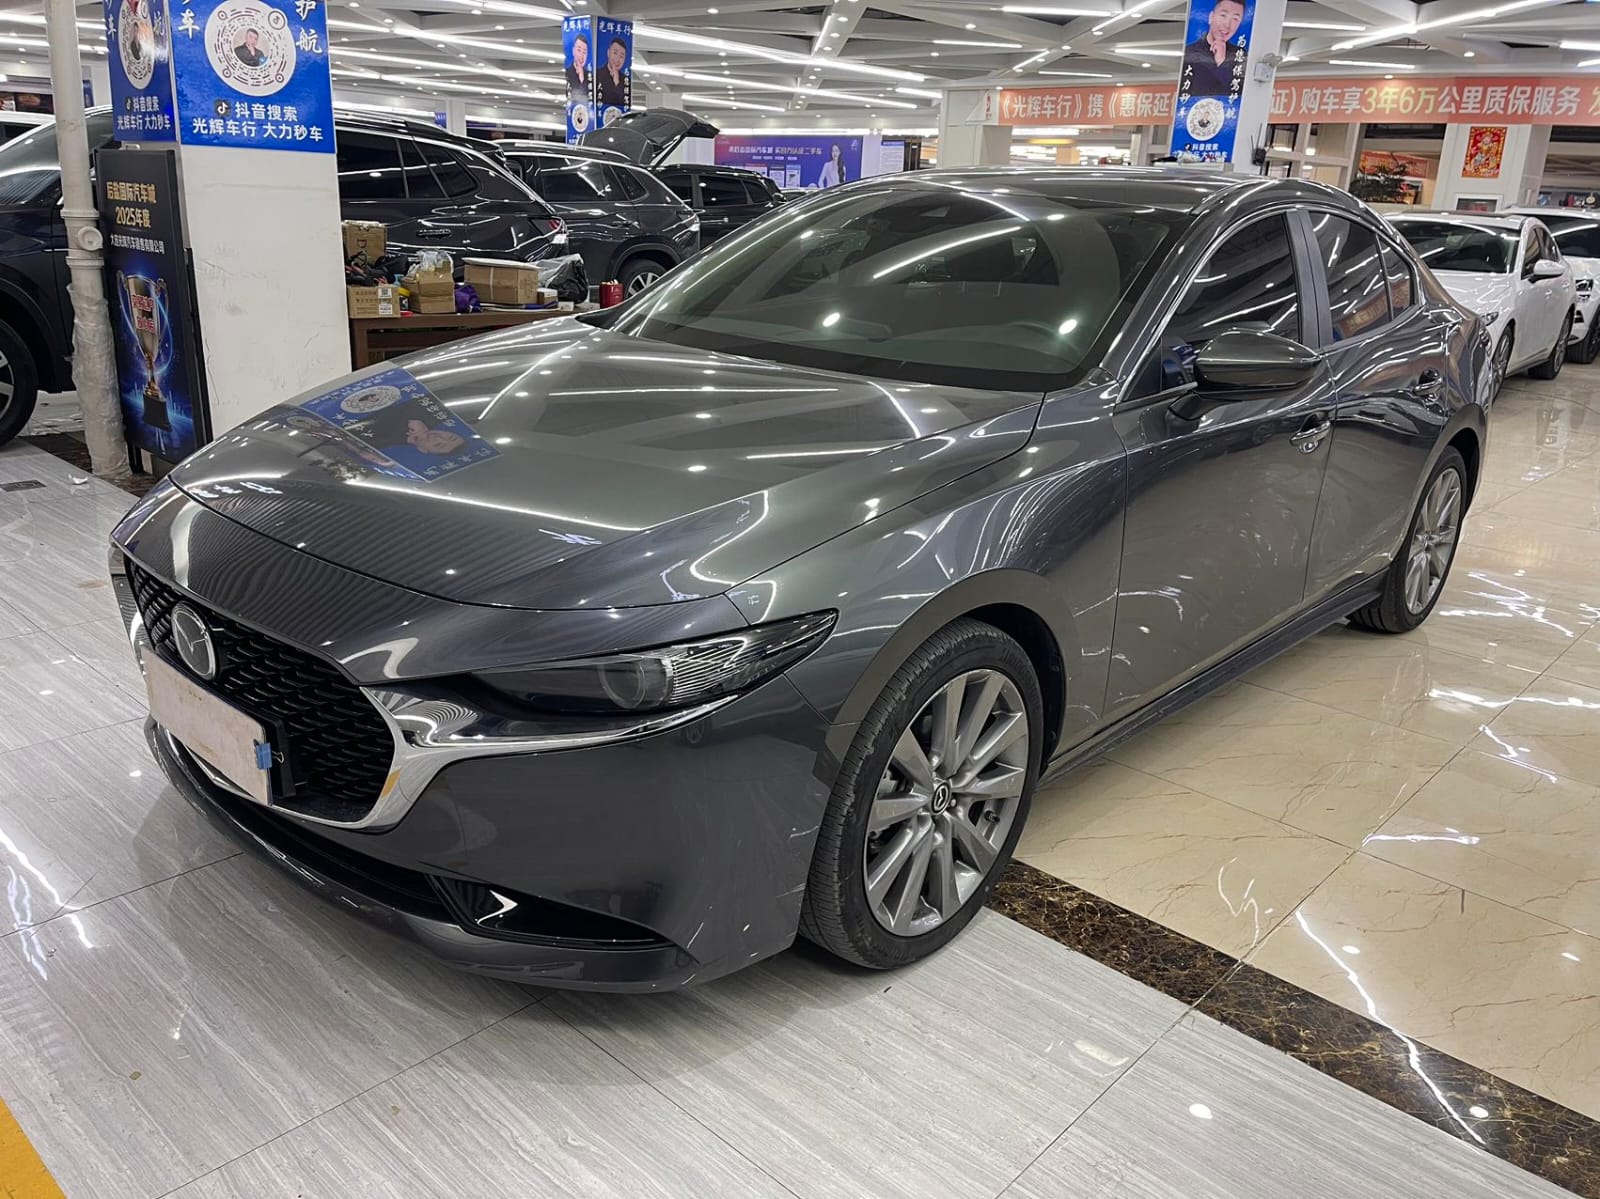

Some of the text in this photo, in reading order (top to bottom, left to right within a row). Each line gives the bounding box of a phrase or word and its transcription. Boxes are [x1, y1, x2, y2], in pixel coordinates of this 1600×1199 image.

[295, 0, 323, 54] 护航
[235, 102, 298, 122] 抖音搜索
[192, 118, 323, 142] 光辉车行 大力秒车
[115, 206, 151, 228] 2025年度
